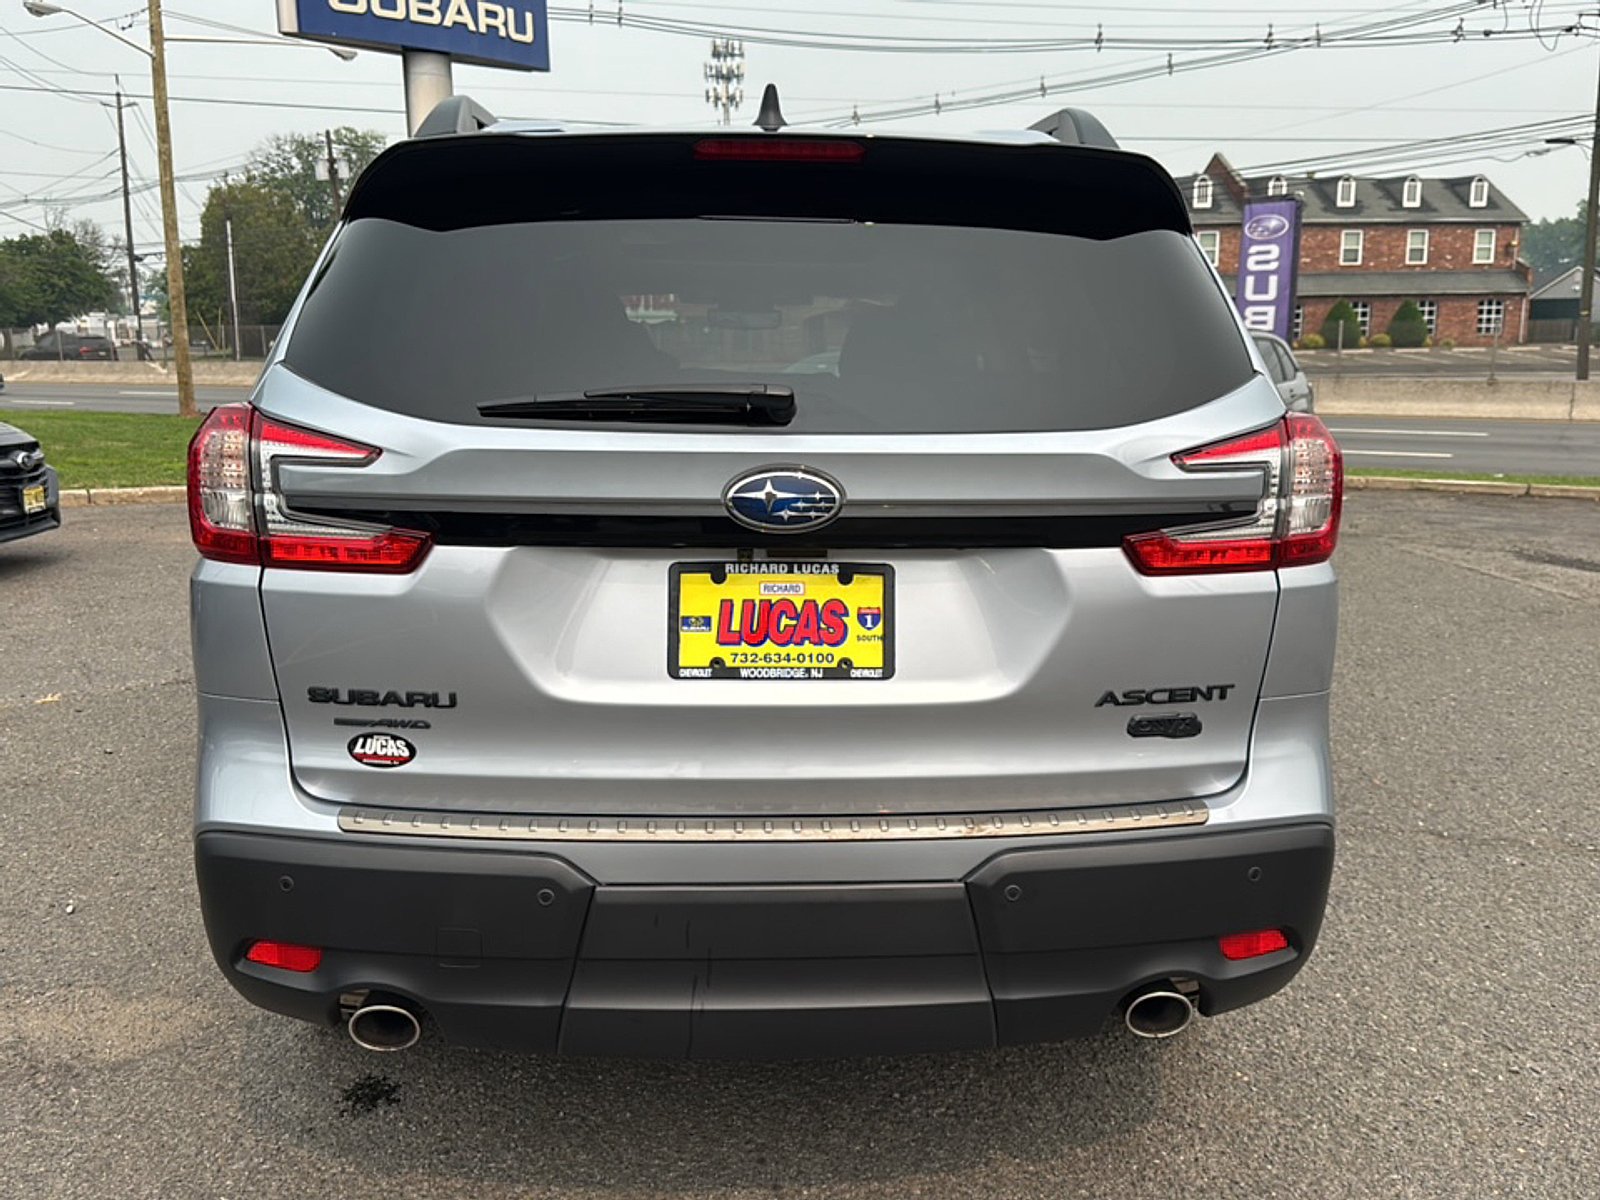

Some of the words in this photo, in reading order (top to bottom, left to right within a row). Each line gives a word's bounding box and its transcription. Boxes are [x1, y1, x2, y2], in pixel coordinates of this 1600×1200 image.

[725, 563, 788, 574] RICHARD
[793, 563, 840, 574] LUCAS
[763, 583, 801, 593] RICHARD
[716, 597, 850, 647] LUCAS
[864, 614, 874, 628] 1
[856, 634, 883, 642] SOUTH
[730, 653, 835, 664] 732-634-0100
[810, 668, 823, 678] NJ
[307, 686, 457, 708] SUBARU
[1094, 684, 1236, 708] ASCENT
[375, 718, 431, 729] AWD
[353, 737, 410, 757] LUCAS
